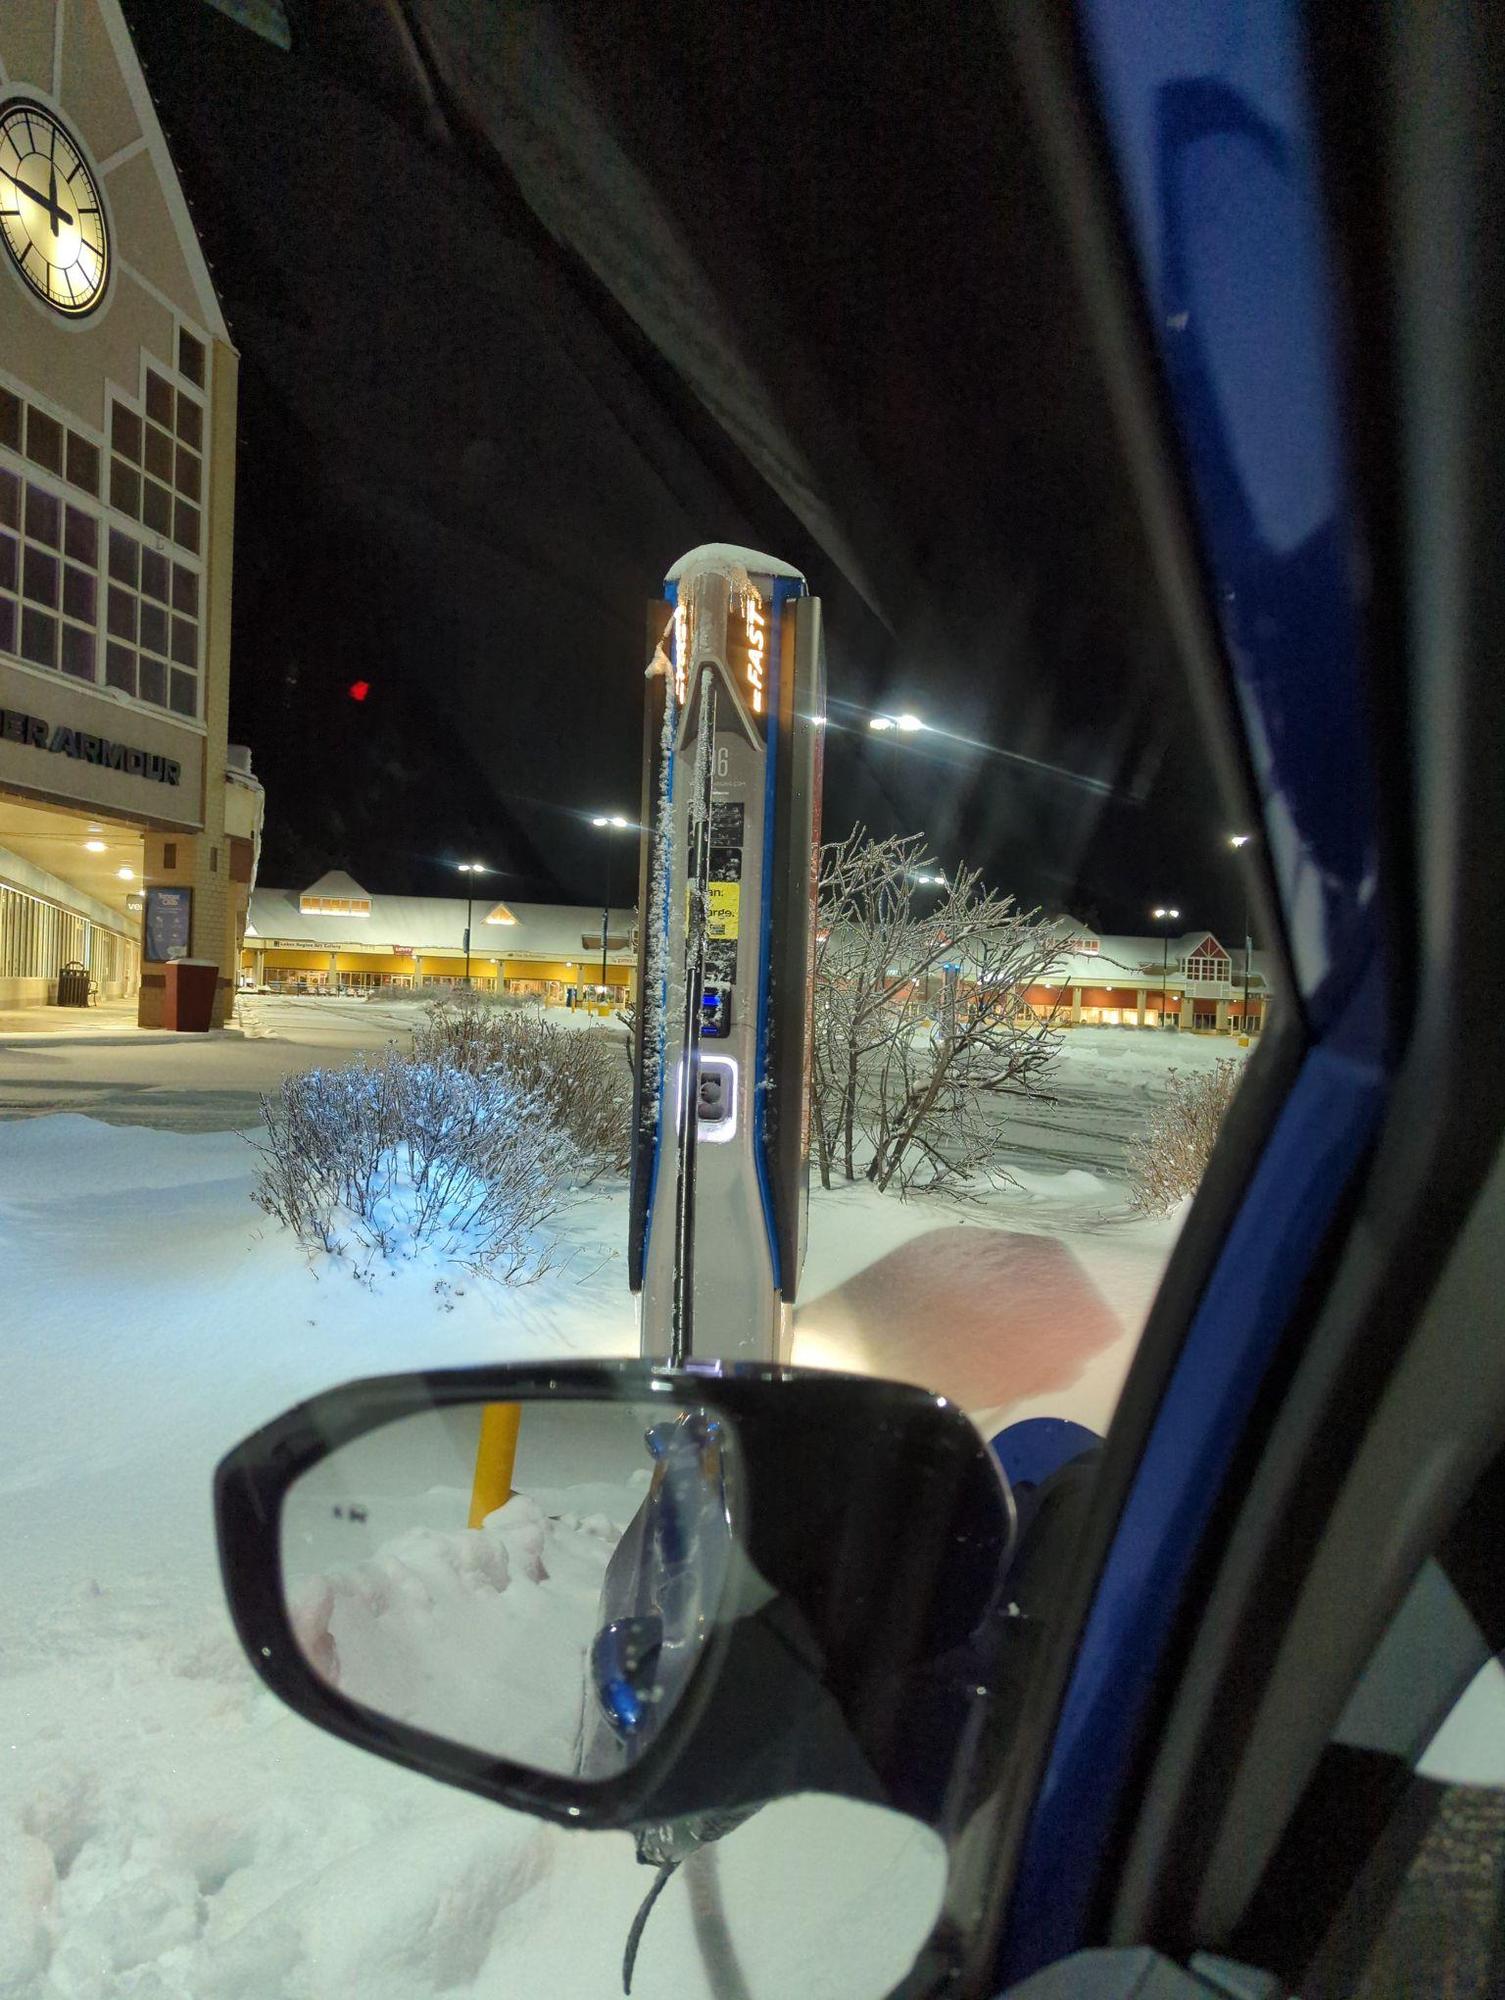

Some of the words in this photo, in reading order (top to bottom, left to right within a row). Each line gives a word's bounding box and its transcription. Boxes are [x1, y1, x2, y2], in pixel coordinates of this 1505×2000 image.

[748, 600, 766, 690] FAST
[0, 708, 49, 749] ER
[49, 726, 182, 786] ARMOUR
[713, 747, 729, 777] 6
